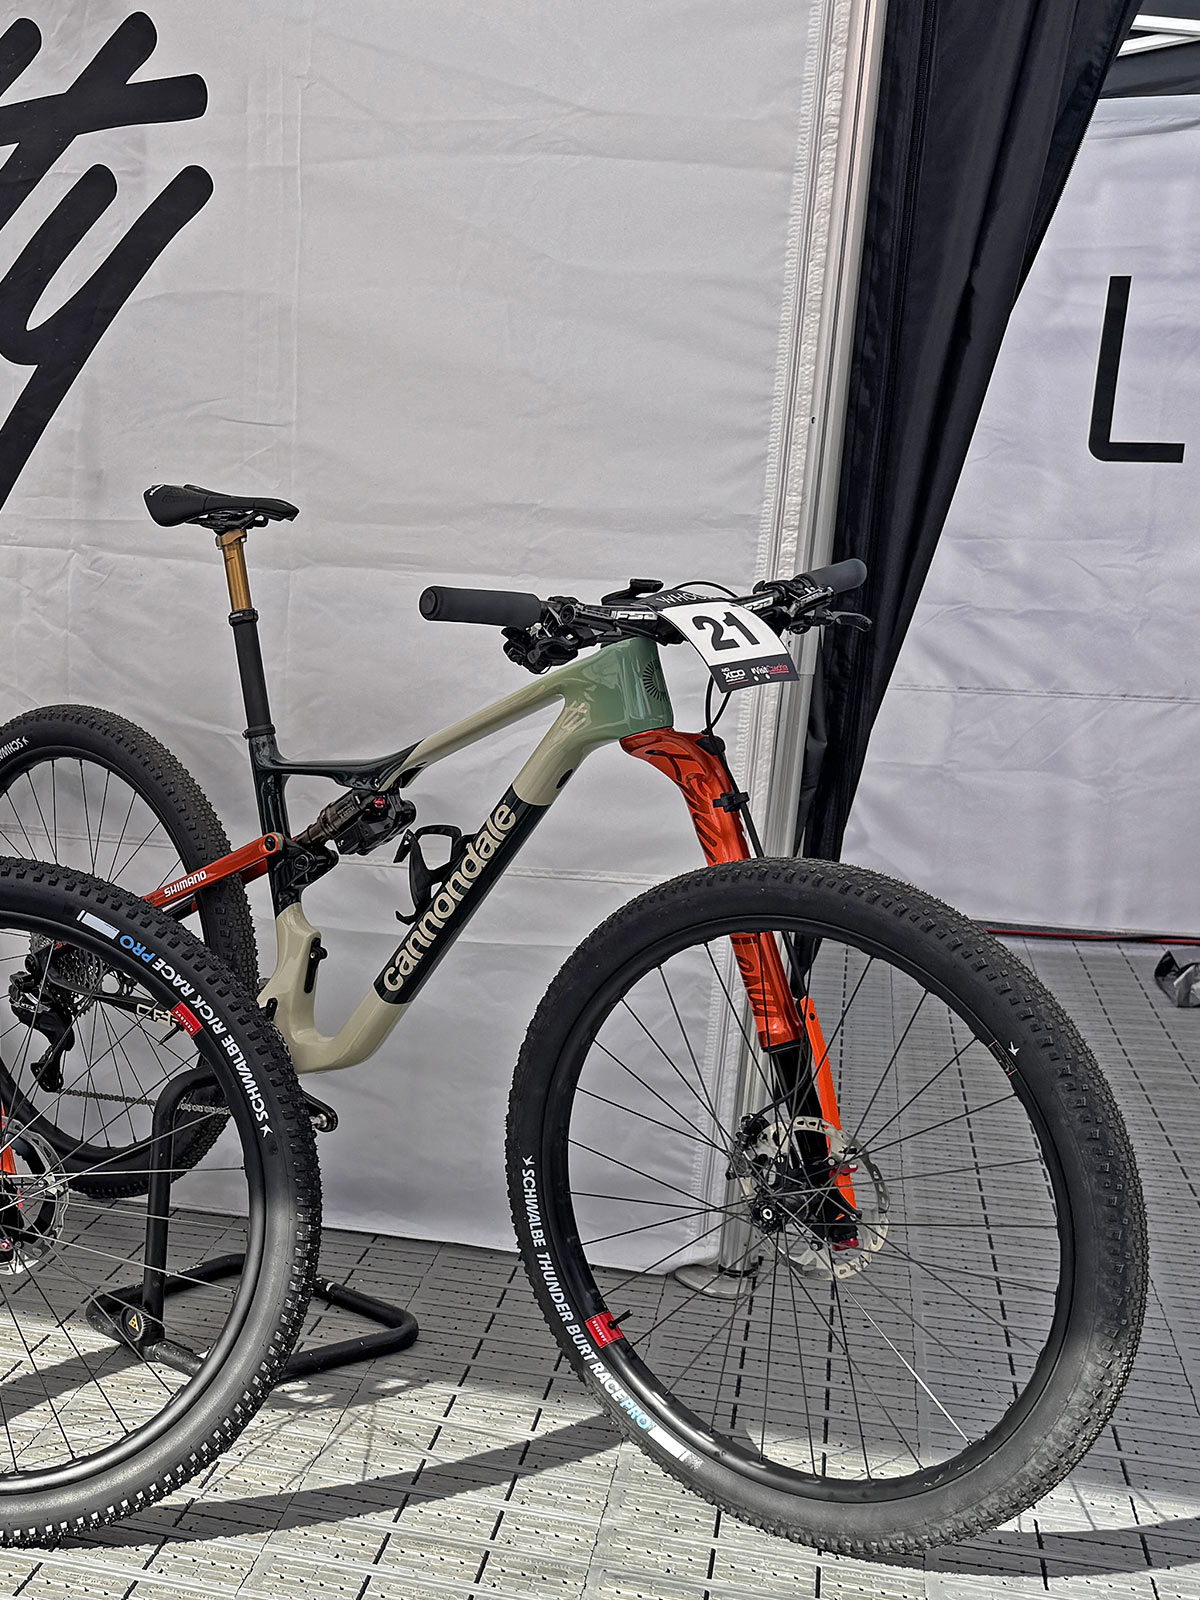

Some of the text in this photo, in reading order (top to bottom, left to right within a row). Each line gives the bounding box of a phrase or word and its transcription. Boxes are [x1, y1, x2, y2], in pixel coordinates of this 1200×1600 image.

[1088, 275, 1185, 463] L
[691, 611, 761, 652] 21
[163, 870, 208, 898] SHIMANO
[383, 803, 517, 992] cannondale
[120, 935, 270, 1123] SCHWALBE RICK RACE PRO
[522, 1168, 654, 1430] SCHWALBE THUNDER BURT RACE PRO
